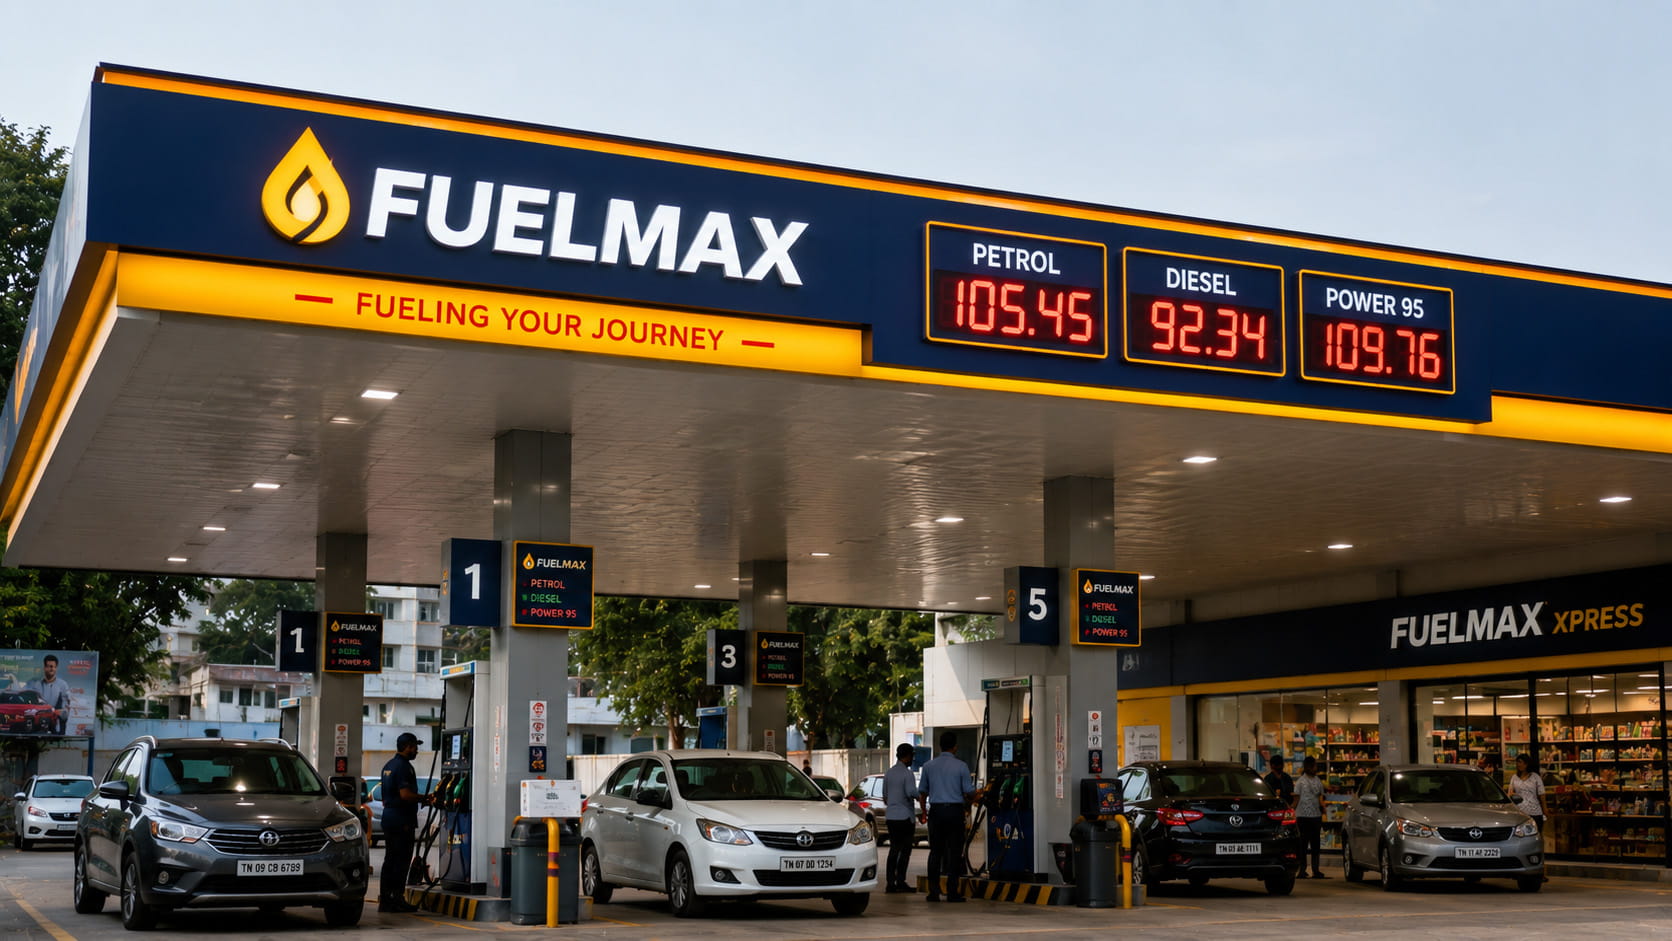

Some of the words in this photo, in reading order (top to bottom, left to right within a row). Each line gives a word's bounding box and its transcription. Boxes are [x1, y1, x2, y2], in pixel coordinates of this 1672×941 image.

[363, 167, 810, 286] FUELMAX
[972, 242, 1061, 275] PETROL
[1166, 267, 1237, 296] DIESEL
[955, 278, 1092, 343] 105.45
[1325, 287, 1396, 315] POWER
[1400, 297, 1424, 319] 95
[356, 292, 490, 329] FUELING
[500, 307, 582, 339] YOUR
[591, 317, 724, 352] JOURNEY
[1150, 301, 1265, 360] 92.34
[1324, 322, 1440, 380] 109.76
[537, 558, 587, 570] FUELMAX
[464, 563, 481, 600] 1
[530, 578, 566, 589] PETROL
[1094, 583, 1134, 594] FUELMAX
[530, 594, 562, 604] DIESEL
[1028, 587, 1048, 621] 5
[530, 607, 564, 618] POWER
[565, 608, 577, 618] 95
[1390, 601, 1544, 649] FUELMAX
[1552, 603, 1644, 634] XPRESS
[290, 627, 305, 653] 1
[341, 623, 377, 632] FUELMAX
[1092, 628, 1118, 637] POWER
[721, 644, 736, 669] 3
[769, 641, 799, 649] FUELMAX
[338, 658, 361, 666] POWER
[241, 864, 253, 872] TN
[255, 863, 265, 872] 09
[281, 863, 301, 872] 6789
[784, 860, 794, 869] TN
[795, 861, 804, 869] 07
[817, 860, 833, 869] 1234
